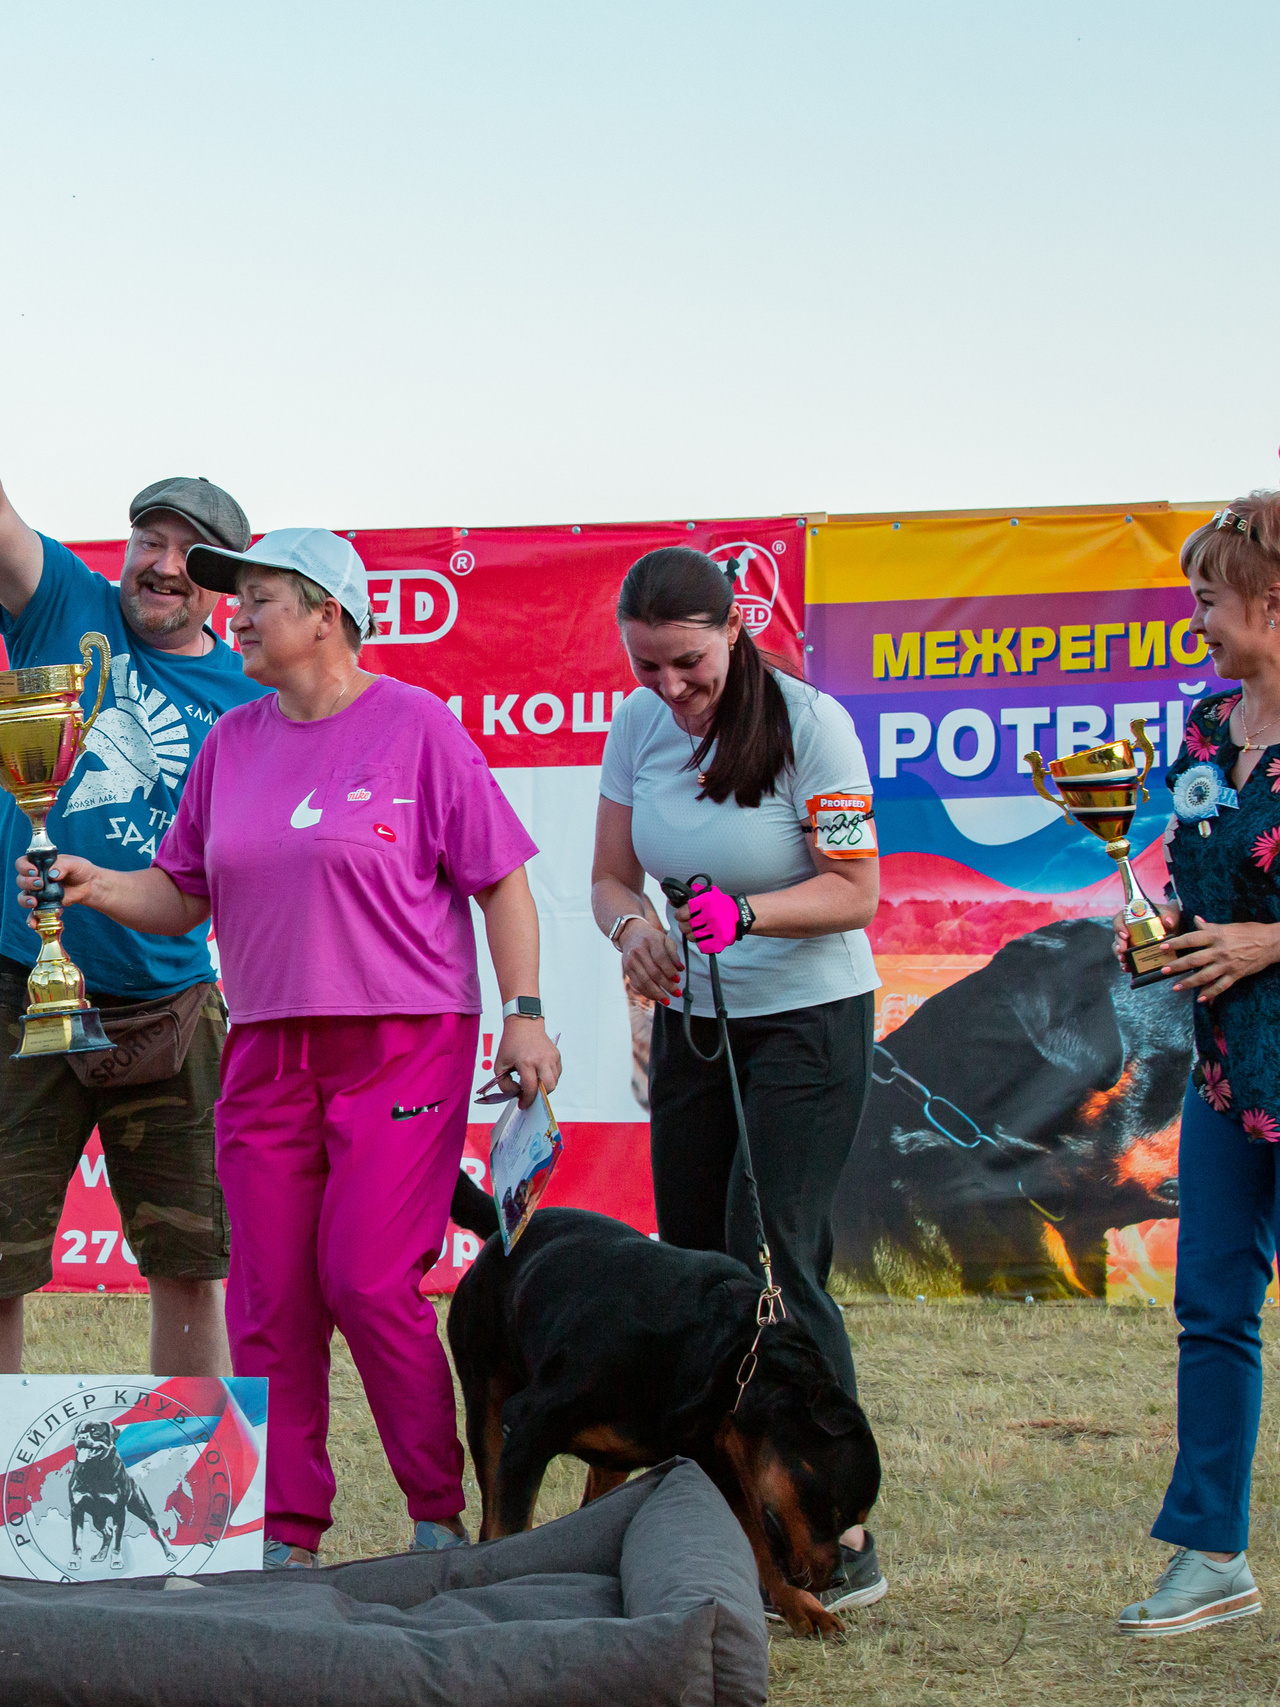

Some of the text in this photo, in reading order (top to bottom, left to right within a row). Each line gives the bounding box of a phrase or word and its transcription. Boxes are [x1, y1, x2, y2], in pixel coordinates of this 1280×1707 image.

[873, 618, 1209, 678] МЕЖРЕГИО
[483, 691, 624, 735] КОШ
[879, 681, 1206, 778] РОТВЕЙ
[348, 789, 371, 800] nike
[821, 799, 865, 808] PROFIFEED
[827, 812, 863, 845] 28
[8, 1390, 229, 1549] РОТВЕЙЛЕР КЛУБ РОССИИ
